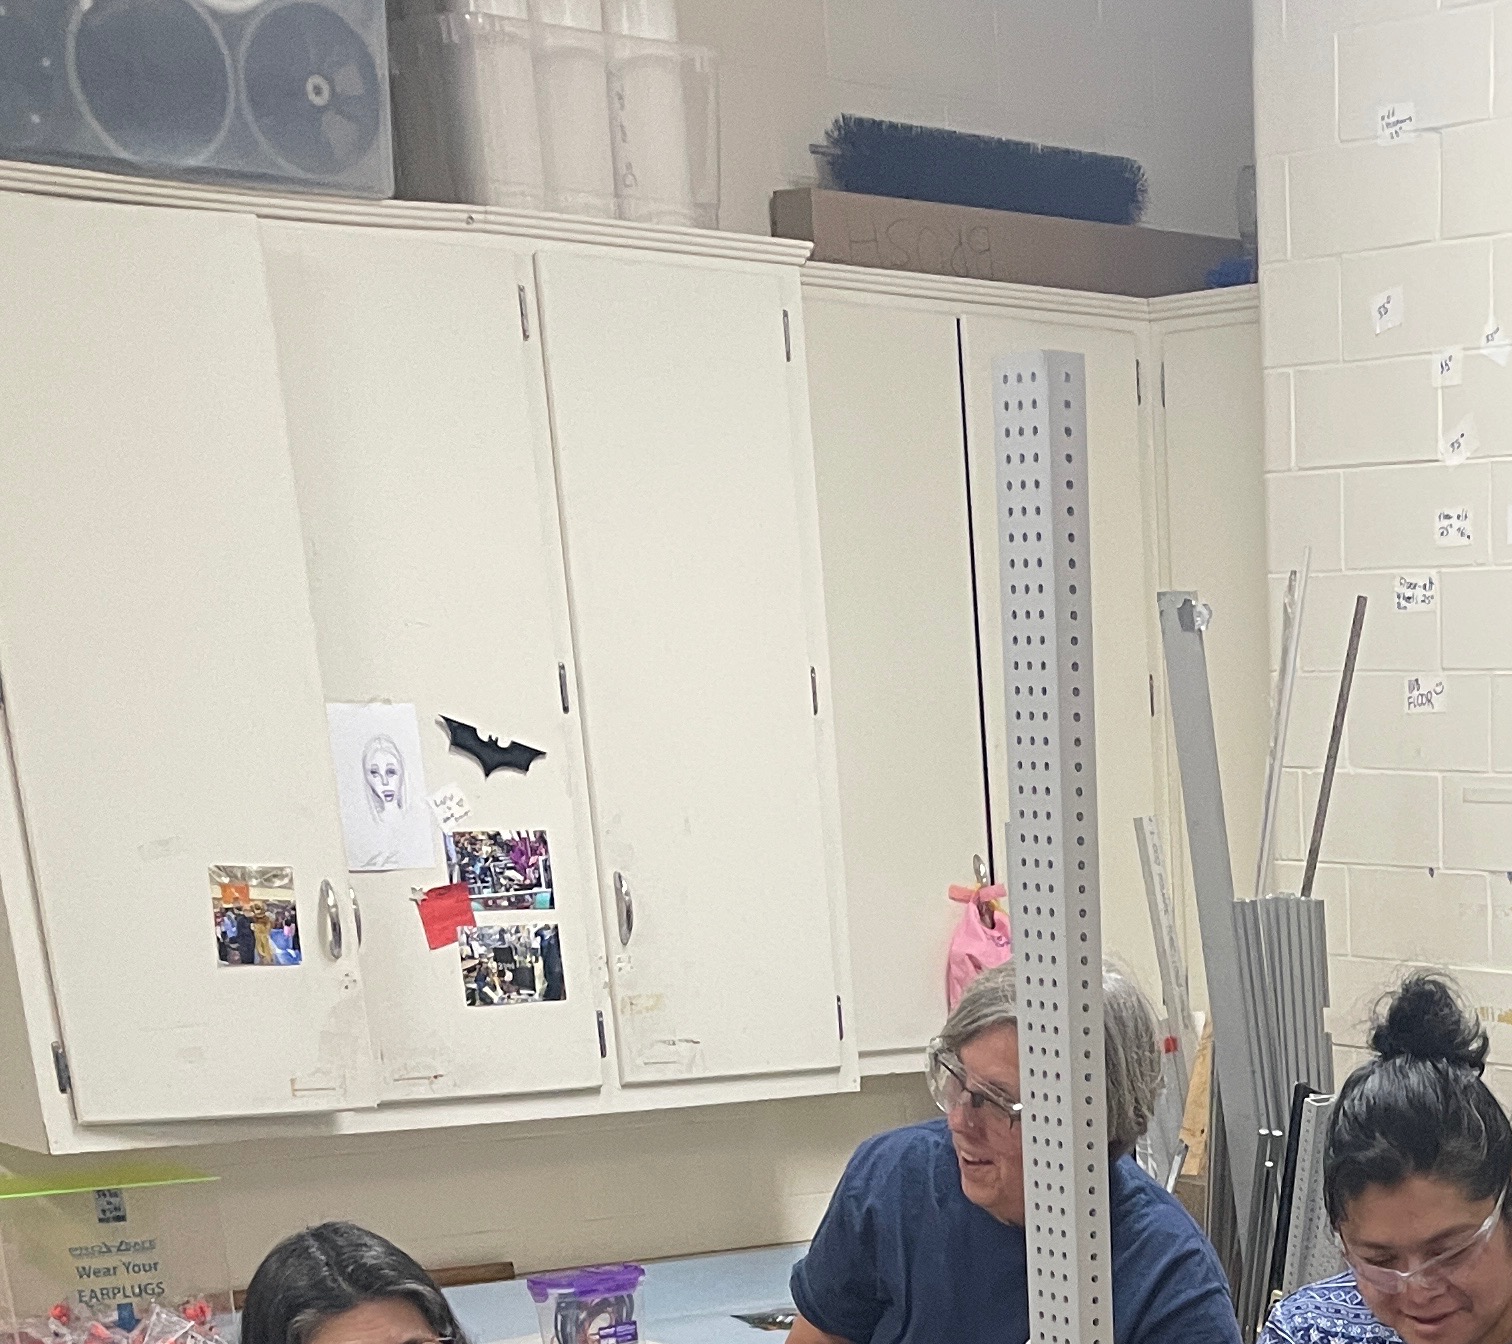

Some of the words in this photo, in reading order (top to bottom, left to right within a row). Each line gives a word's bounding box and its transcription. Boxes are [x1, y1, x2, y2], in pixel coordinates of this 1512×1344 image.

[75, 1264, 118, 1280] Wear
[120, 1260, 159, 1275] Your
[77, 1281, 165, 1304] EARPLUGS
